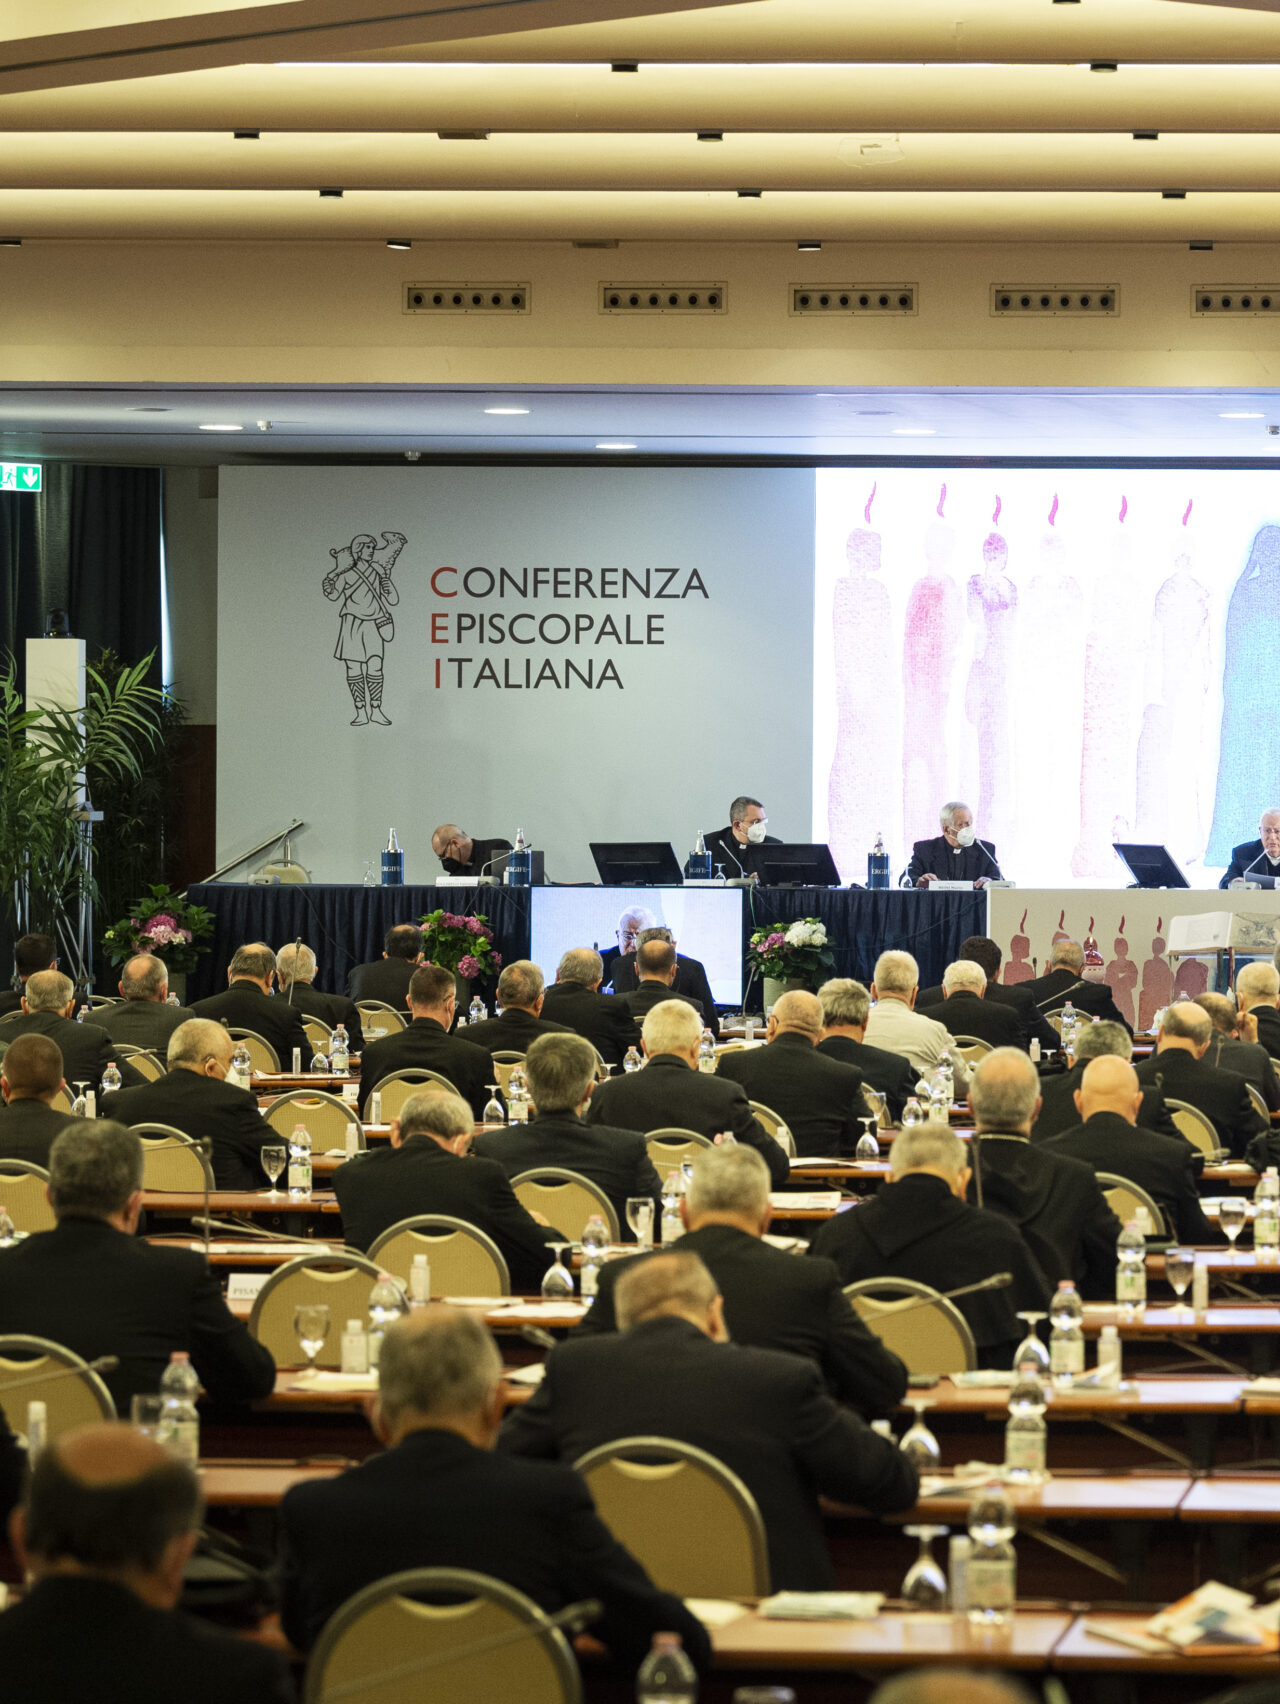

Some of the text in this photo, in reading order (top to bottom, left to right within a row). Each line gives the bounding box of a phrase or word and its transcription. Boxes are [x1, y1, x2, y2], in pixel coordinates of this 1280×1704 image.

[430, 567, 709, 599] CONFERENZA
[430, 613, 665, 645] EPISCOPALE
[434, 657, 624, 690] ITALIANA
